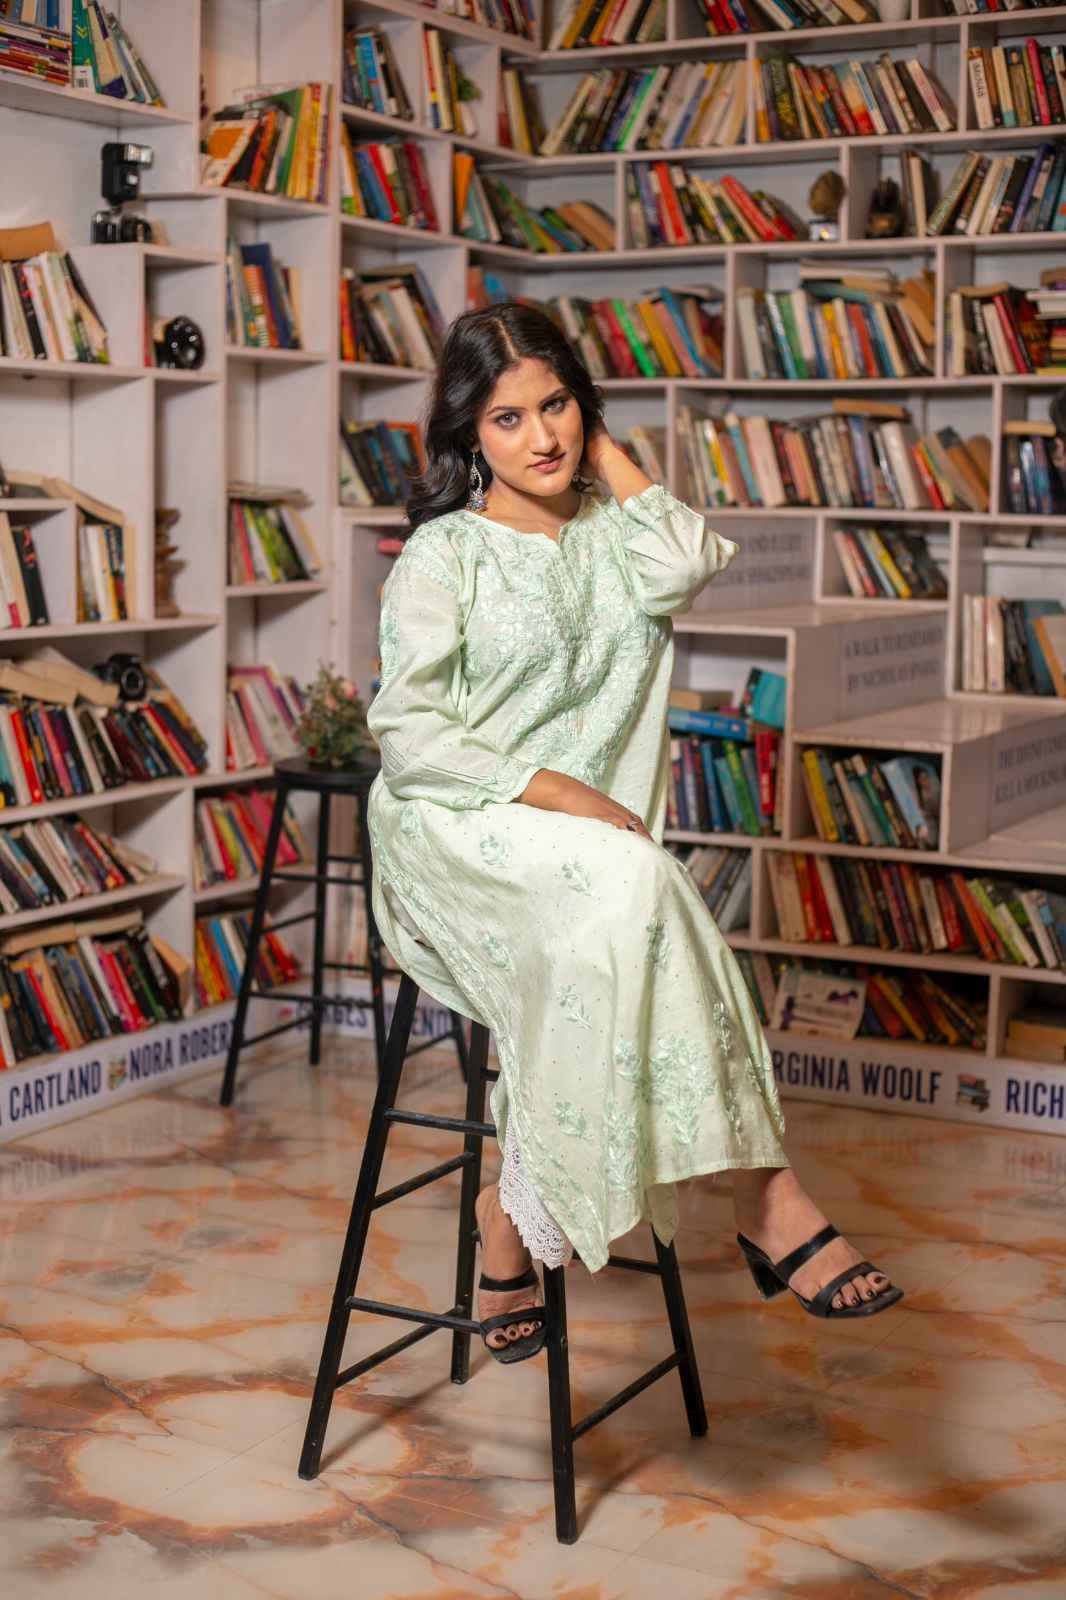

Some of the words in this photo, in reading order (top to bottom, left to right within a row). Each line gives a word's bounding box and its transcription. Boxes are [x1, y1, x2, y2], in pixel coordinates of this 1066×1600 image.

[130, 1036, 174, 1082] NORA
[179, 1019, 234, 1065] ROBER
[771, 1049, 850, 1092] RGINIA
[861, 1062, 942, 1105] WOOLF
[9, 1060, 102, 1123] CARTLAND
[1006, 1079, 1064, 1119] RICH
